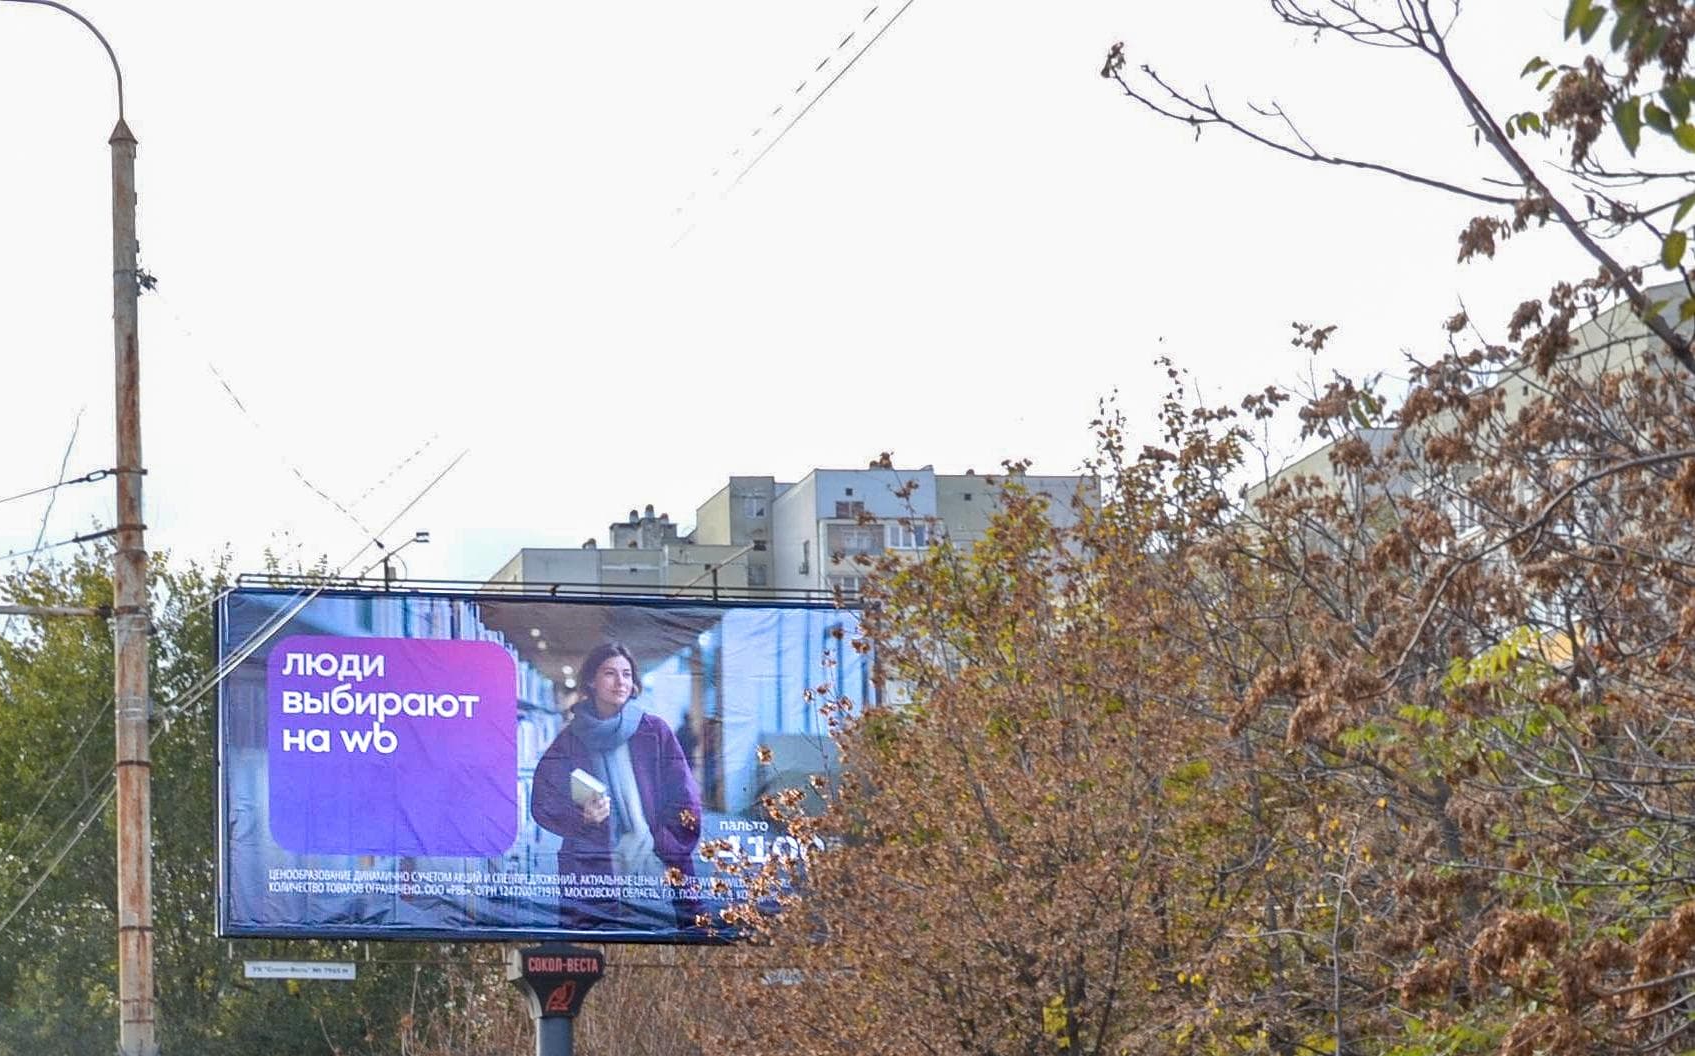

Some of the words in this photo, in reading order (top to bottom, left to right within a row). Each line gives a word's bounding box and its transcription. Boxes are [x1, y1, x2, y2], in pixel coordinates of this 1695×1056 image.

[281, 652, 385, 682] люди
[282, 683, 480, 723] выбирают
[282, 728, 331, 752] на
[339, 721, 398, 753] wb
[719, 820, 769, 832] пальто
[268, 869, 351, 881] ЦЕНООБРАЗОВАНИЕ
[268, 882, 324, 893] КОЛИЧЕСТВО
[326, 883, 364, 894] ТОВАРОВ
[425, 885, 445, 896] ООО
[528, 956, 599, 973] СОКОЛ-ВЕСТА
